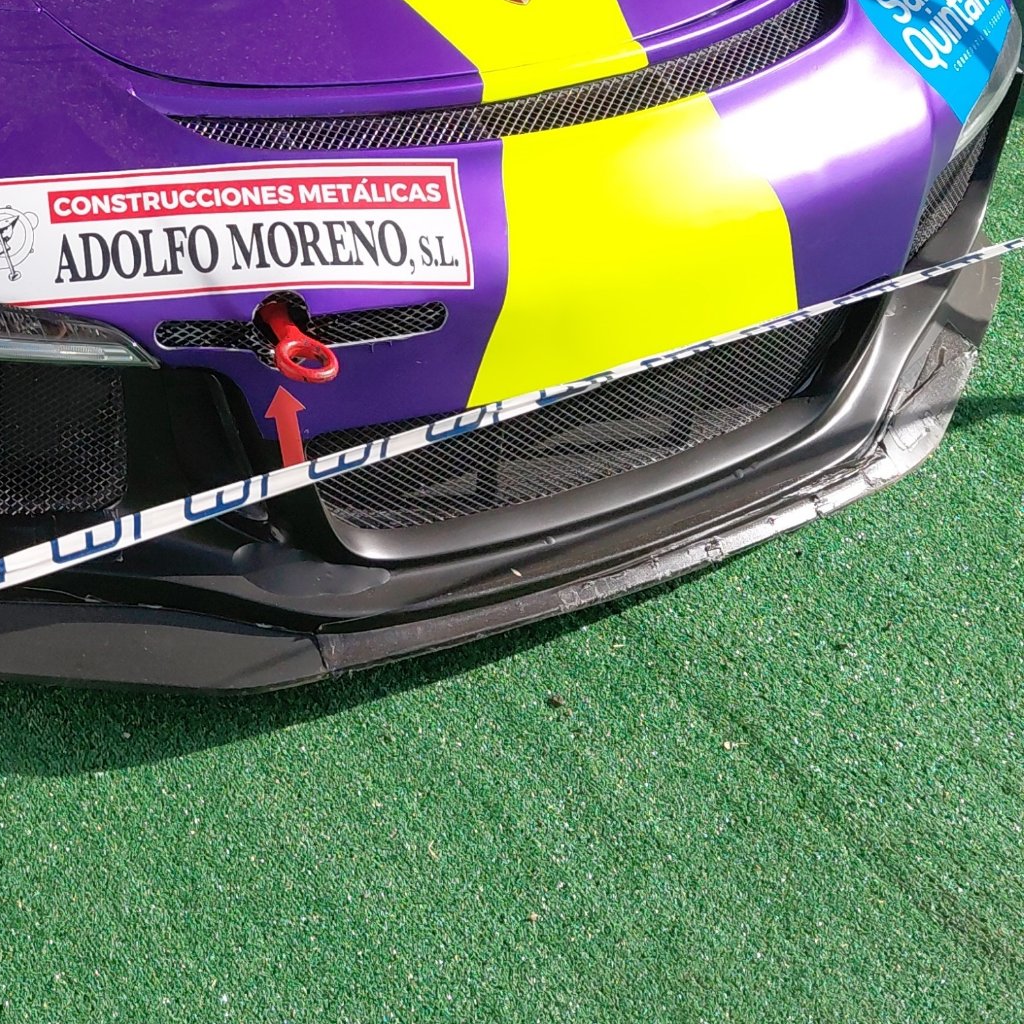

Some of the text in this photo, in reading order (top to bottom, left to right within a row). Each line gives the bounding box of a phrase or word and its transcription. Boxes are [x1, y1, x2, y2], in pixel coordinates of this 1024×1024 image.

[52, 177, 444, 217] CONSTRUCCIONES METÁLICAS
[54, 224, 220, 284] ADOLFO
[420, 233, 460, 268] S.L.
